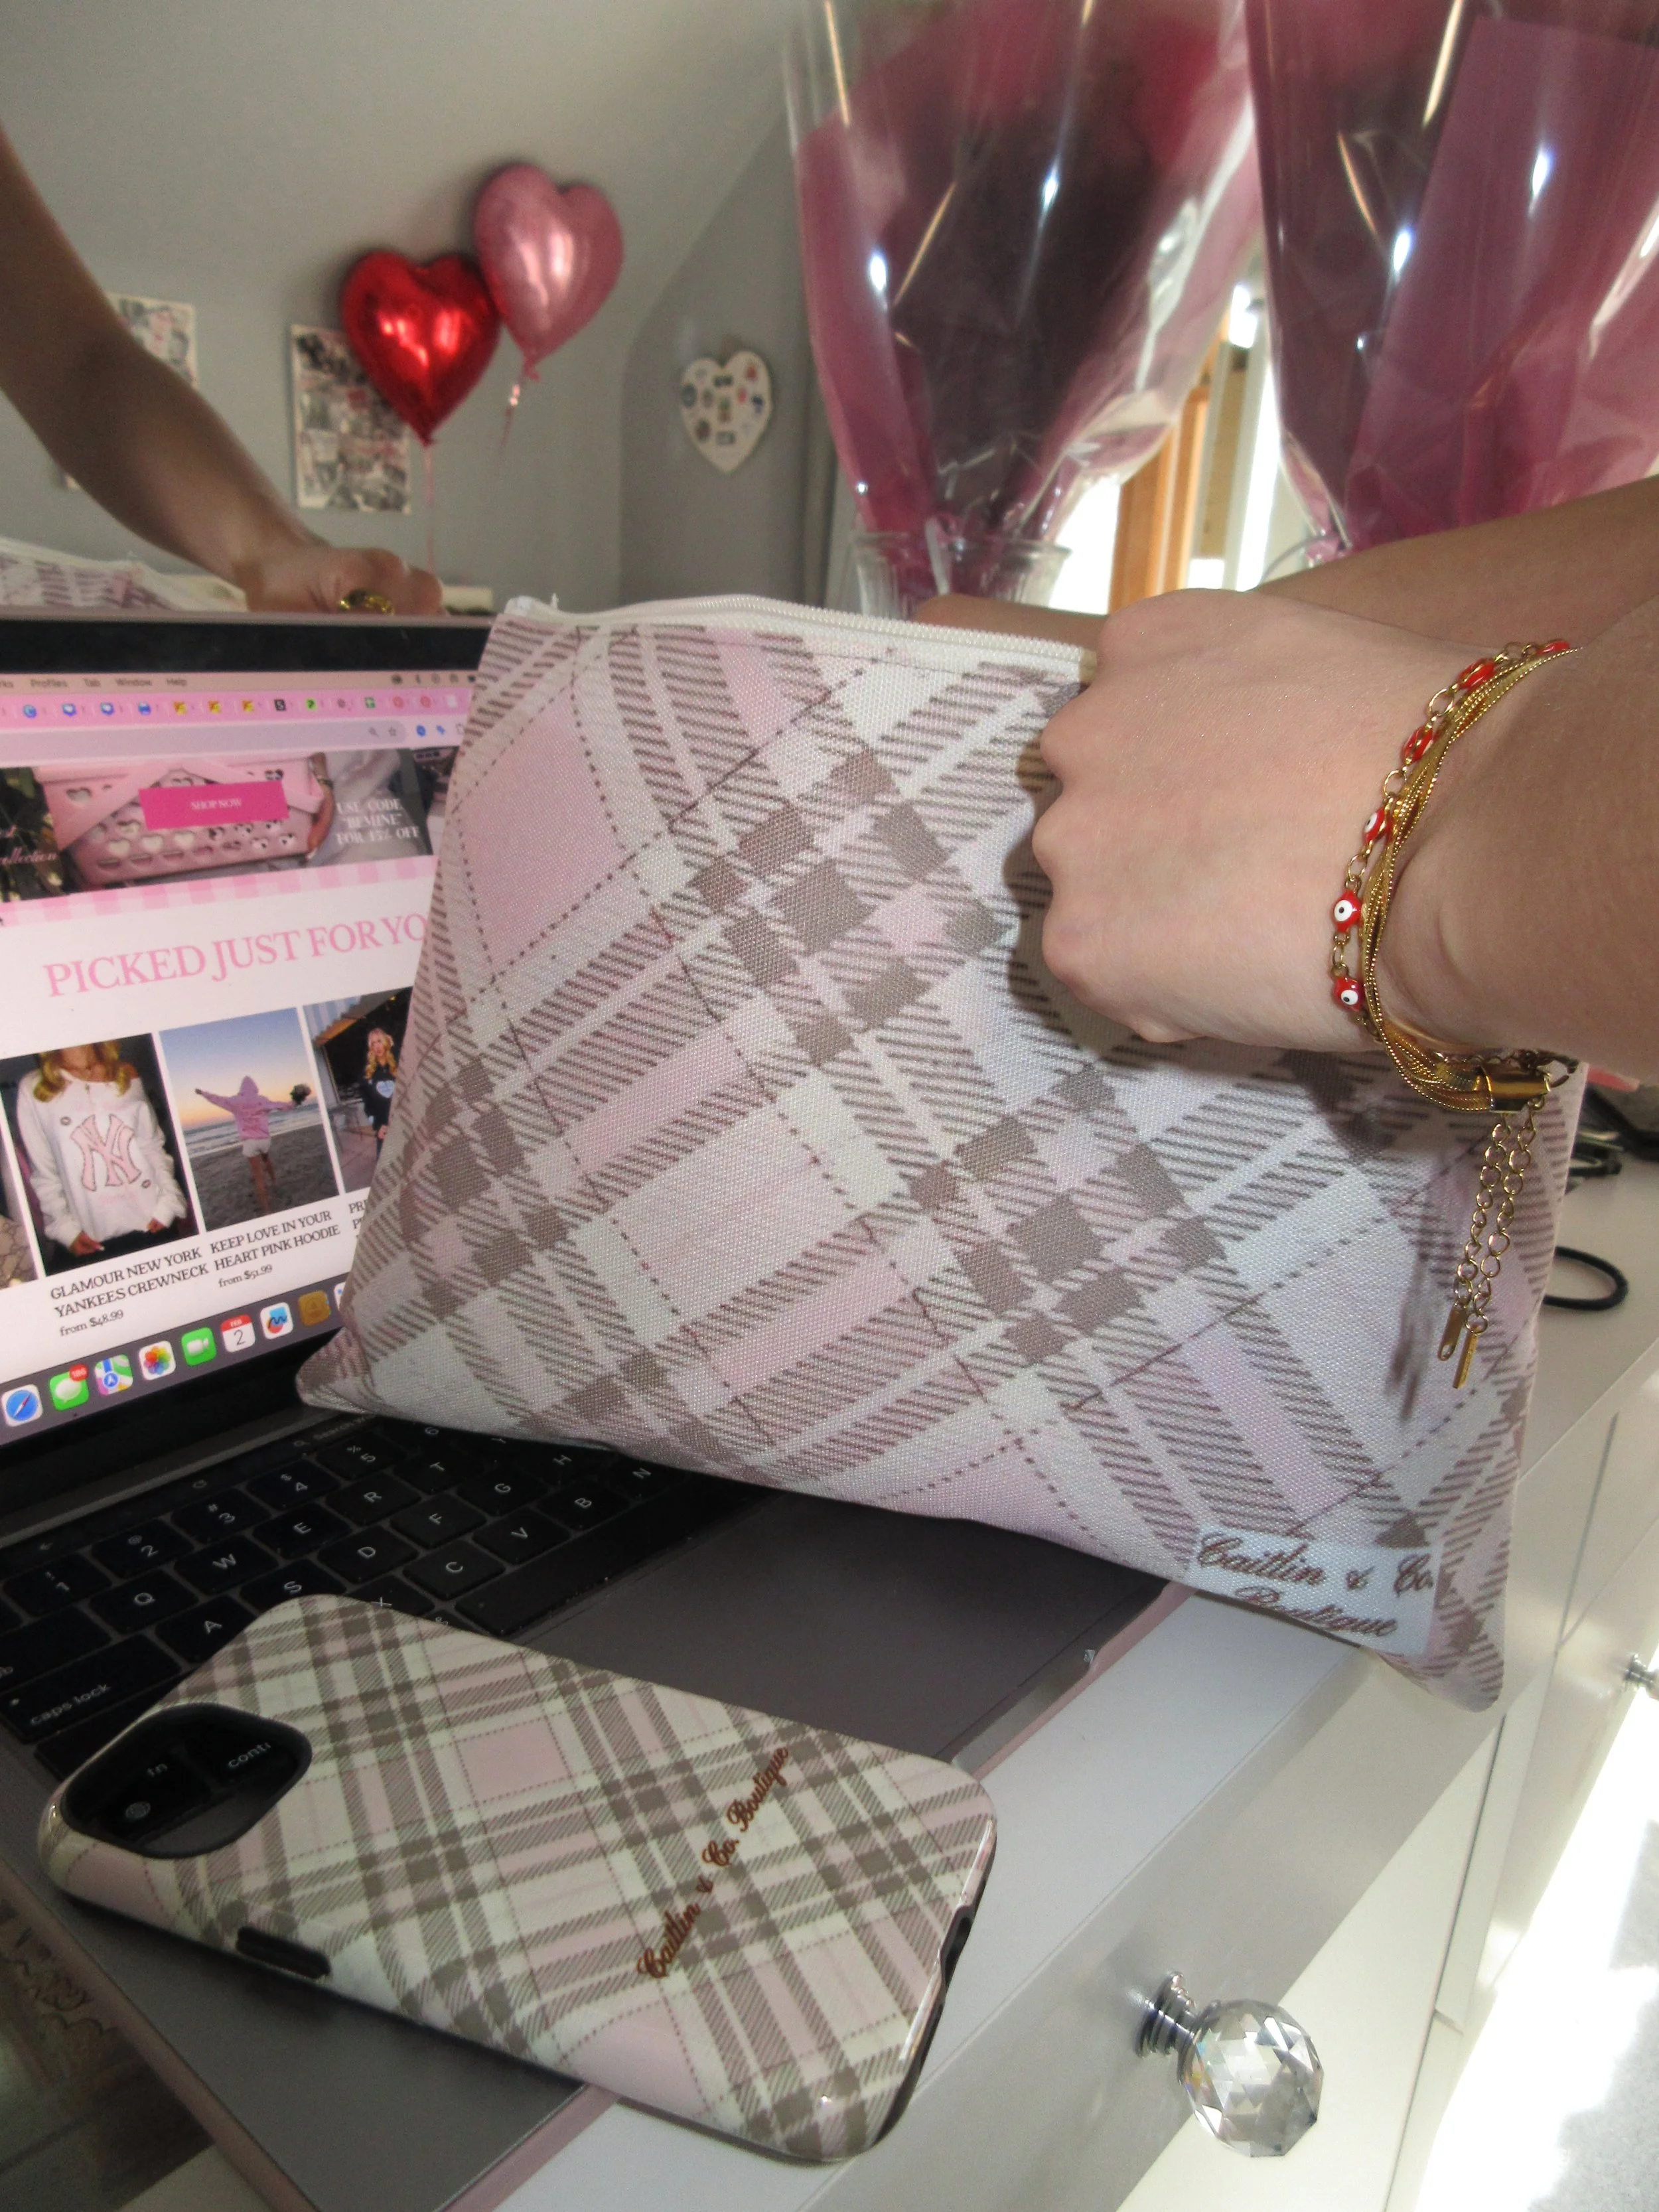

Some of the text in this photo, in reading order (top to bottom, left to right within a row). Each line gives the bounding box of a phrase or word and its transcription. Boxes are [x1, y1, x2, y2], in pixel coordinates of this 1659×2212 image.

[190, 797, 242, 810] SHOP NOW
[43, 913, 428, 997] PICKED JUST FOR YO
[210, 1234, 245, 1254] KEEP
[246, 1224, 281, 1243] LOVE
[282, 1220, 297, 1233] IN
[297, 1210, 332, 1228] YOUR
[214, 1224, 341, 1271] HEART PINK HOODIE
[50, 1247, 202, 1300] GLAMOUR NEW YORK
[218, 1274, 243, 1288] from
[54, 1263, 210, 1318] YANKEES CREWNECK
[60, 1321, 88, 1337] from
[234, 1329, 246, 1345] 2
[360, 1453, 376, 1463] 5
[430, 1461, 445, 1471] T
[632, 1467, 651, 1479] N
[295, 1482, 308, 1492] 4
[494, 1482, 511, 1494] G
[364, 1491, 382, 1503] R
[575, 1497, 592, 1509] B
[218, 1512, 236, 1524] 3
[429, 1512, 443, 1525] F
[293, 1522, 311, 1534] E
[510, 1527, 529, 1539] V
[141, 1544, 159, 1558] 2
[356, 1546, 376, 1559] D
[212, 1553, 236, 1570] W
[445, 1561, 463, 1573] C
[56, 1582, 70, 1591] 1
[284, 1580, 302, 1595] S
[134, 1592, 155, 1606] Q
[204, 1619, 222, 1635] A
[29, 1683, 111, 1726] caps lock
[636, 1903, 701, 1979] Caitlin
[727, 1746, 788, 1833] Boutique
